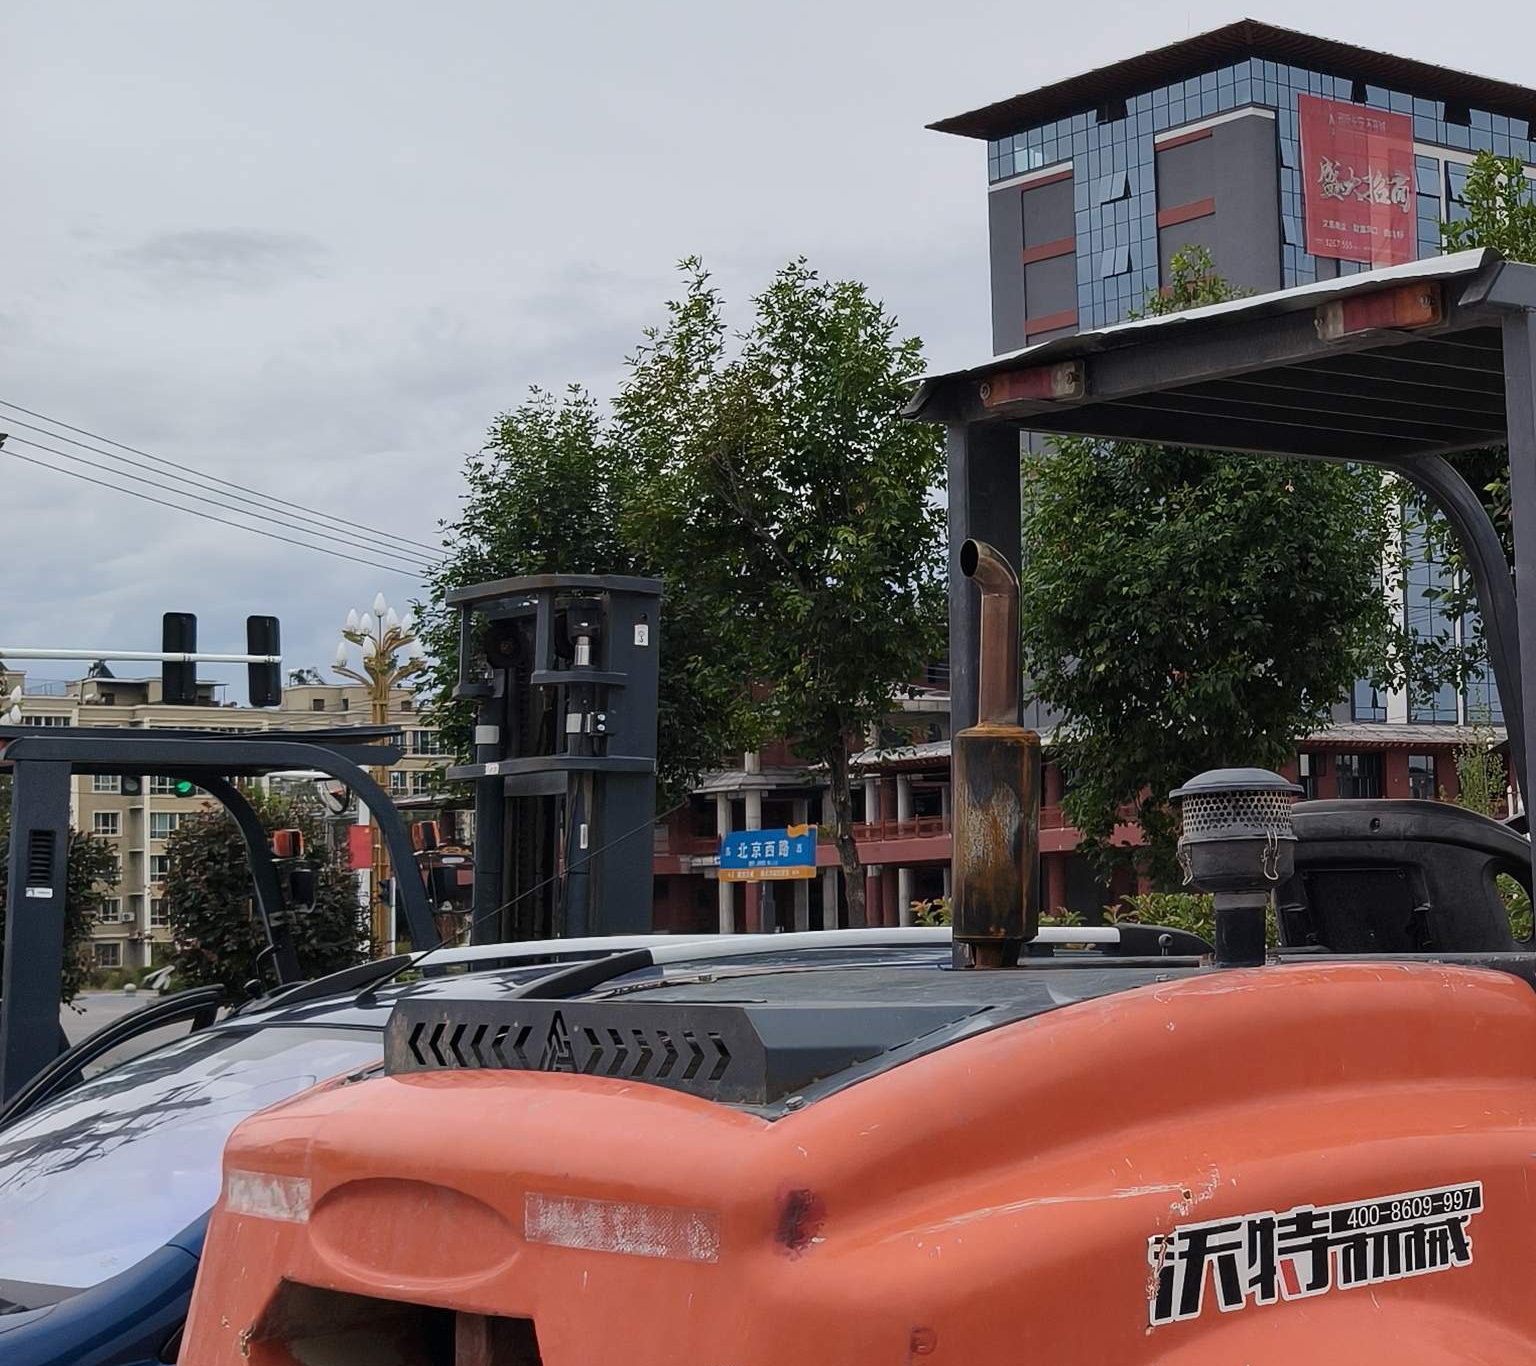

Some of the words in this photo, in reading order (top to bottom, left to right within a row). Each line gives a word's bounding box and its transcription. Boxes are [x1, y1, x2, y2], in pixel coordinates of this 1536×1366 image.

[1317, 155, 1411, 213] 盛大招商
[737, 839, 790, 859] 北京西路
[1346, 1188, 1474, 1228] 400-8609-997
[1152, 1210, 1471, 1320] 沃特机械
